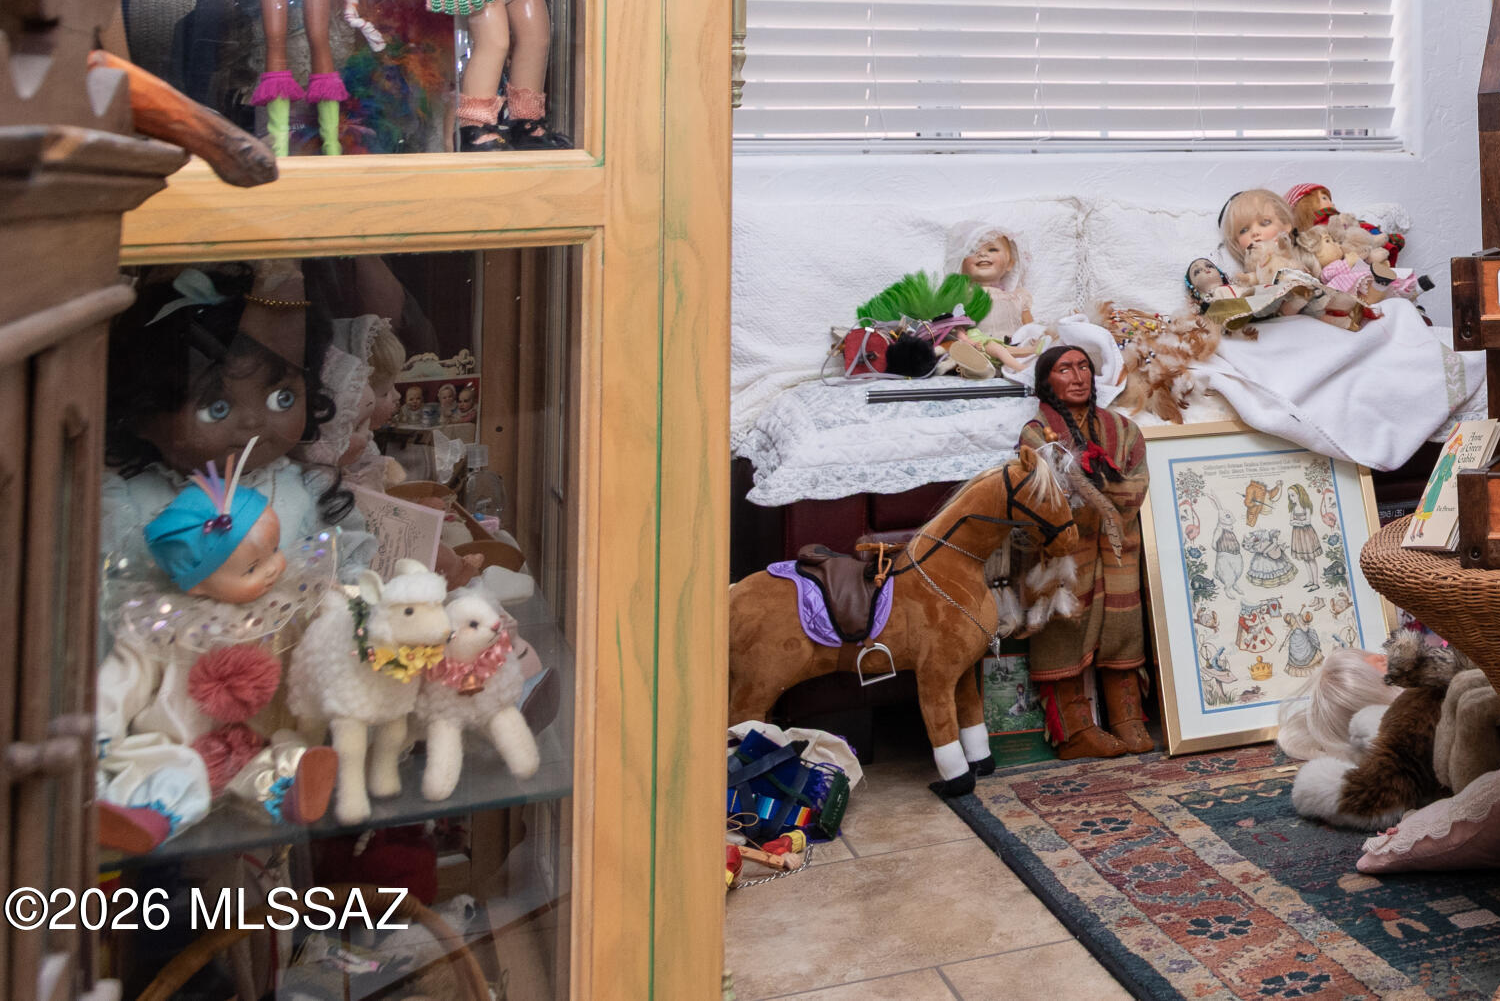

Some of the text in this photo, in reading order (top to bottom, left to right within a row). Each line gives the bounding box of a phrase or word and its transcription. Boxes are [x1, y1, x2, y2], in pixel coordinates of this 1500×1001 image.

[1468, 432, 1484, 442] Anne
[1466, 442, 1483, 453] Green
[1457, 453, 1477, 464] Gables
